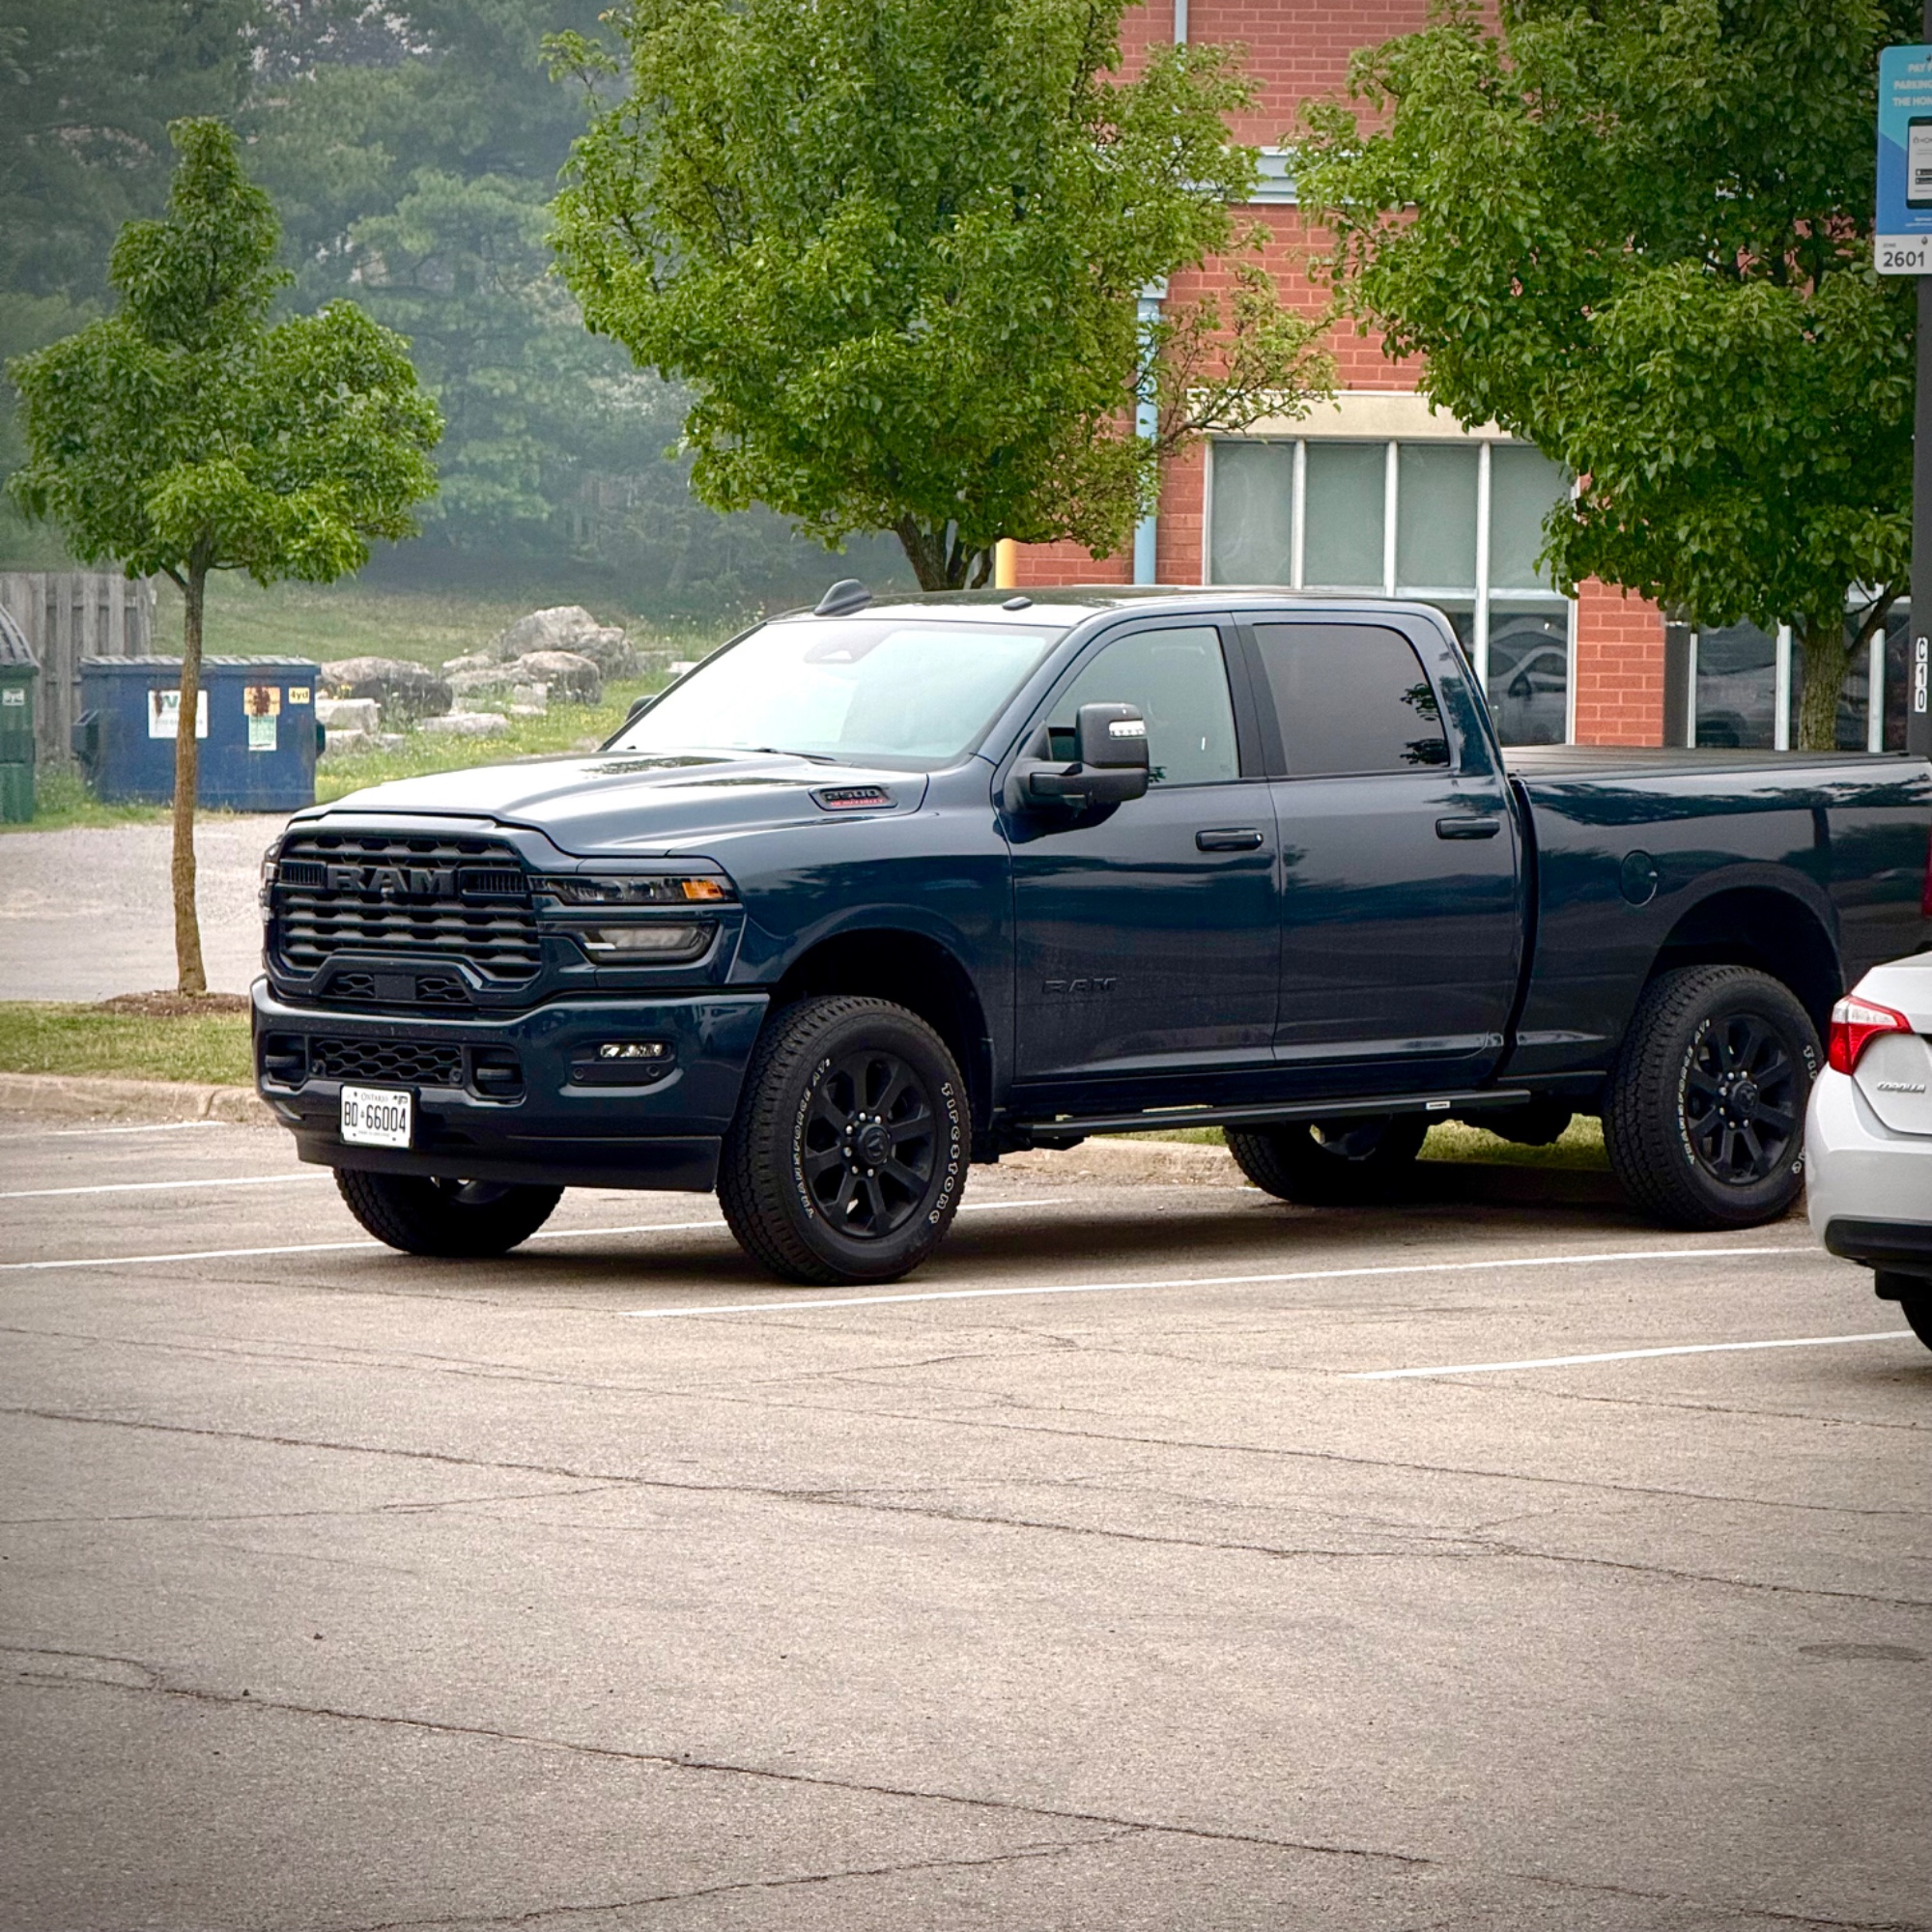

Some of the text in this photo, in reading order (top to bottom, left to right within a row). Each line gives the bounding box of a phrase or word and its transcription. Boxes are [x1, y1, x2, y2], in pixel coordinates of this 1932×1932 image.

[1892, 98, 1911, 106] THE
[1883, 251, 1924, 268] 2601
[1918, 639, 1926, 710] C10
[291, 690, 309, 700] 4yd
[327, 865, 456, 895] RAM
[1042, 978, 1116, 992] RAM
[366, 1104, 406, 1133] 66004
